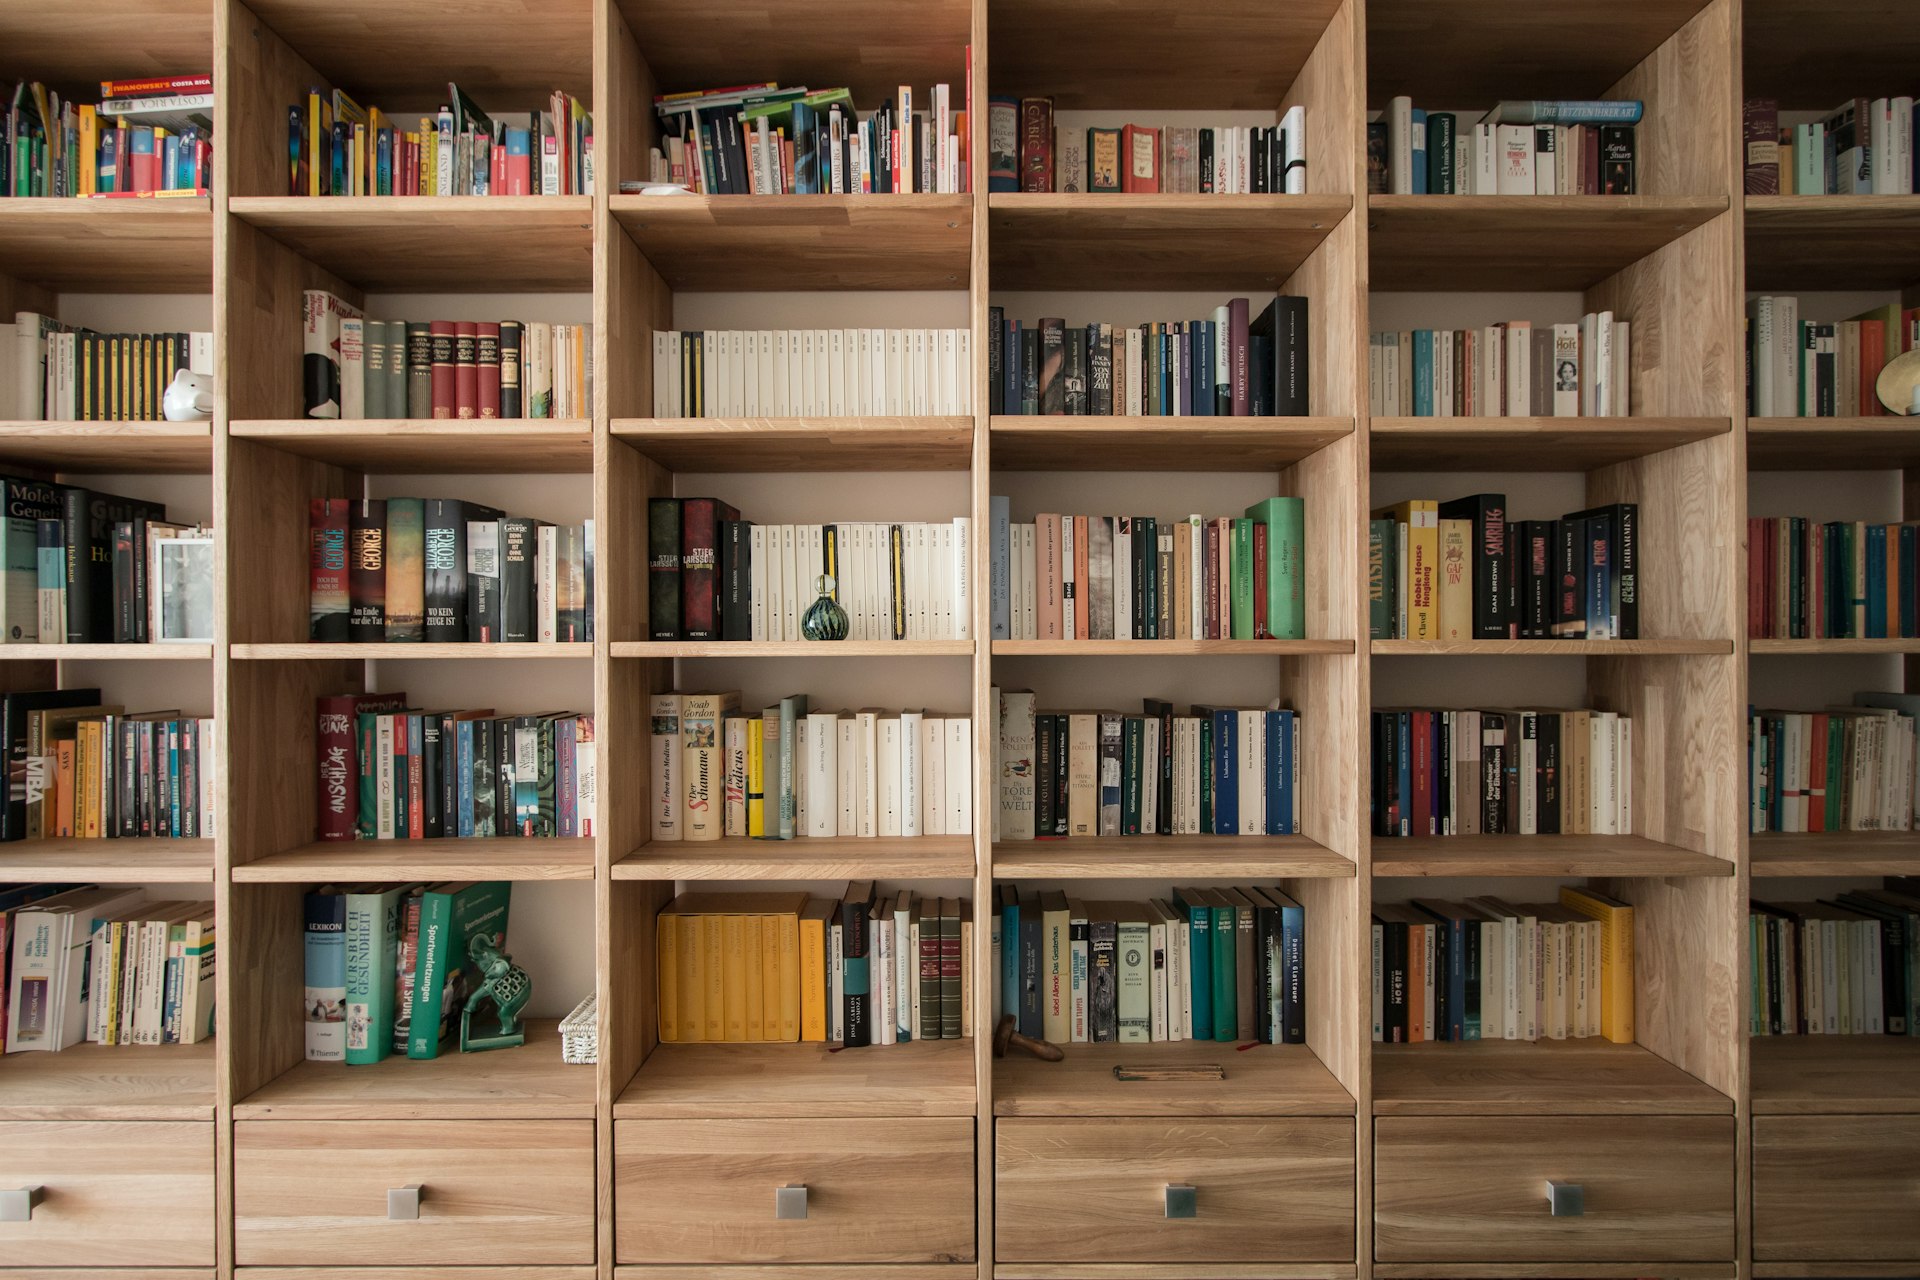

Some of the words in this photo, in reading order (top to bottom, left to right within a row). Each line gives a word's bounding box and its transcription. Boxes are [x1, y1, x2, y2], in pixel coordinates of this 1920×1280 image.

[113, 81, 170, 92] IWANOWSKI'S
[171, 79, 193, 88] COSTA
[194, 78, 211, 86] RICA
[140, 98, 165, 109] RICA
[168, 95, 205, 107] COSTA
[1543, 108, 1558, 117] DIE
[1557, 108, 1594, 117] LETZTEN
[1594, 108, 1620, 117] IHRER
[1621, 108, 1637, 117] ART
[993, 140, 1013, 149] Rose
[1605, 144, 1626, 152] Maria
[752, 146, 760, 170] AMRUM
[832, 148, 841, 193] HAMBURG
[1557, 340, 1576, 349] Holt
[1485, 508, 1504, 555] SAKRILEG
[325, 528, 345, 571] GEORGE
[362, 528, 382, 571] GEORGE
[426, 528, 437, 570] ELIZABETH
[437, 528, 455, 571] GEORGE
[1623, 514, 1631, 569] ERBARMEN
[683, 555, 715, 564] LARSSON
[692, 548, 714, 557] STIEG
[1594, 539, 1606, 566] METEOR
[68, 545, 76, 583] Holocaust
[650, 560, 679, 568] LARSSON
[1423, 567, 1431, 607] Hongkong
[351, 617, 362, 625] war
[371, 616, 383, 625] Tat
[353, 608, 362, 616] Am
[363, 608, 379, 616] Ende
[428, 608, 437, 616] WO
[438, 608, 454, 616] KEIN
[427, 617, 445, 625] ZEUGE
[446, 617, 456, 625] IST
[684, 709, 714, 717] Gordon
[689, 701, 709, 709] Noah
[320, 722, 349, 735] KING
[321, 761, 329, 778] DER
[727, 750, 744, 806] Medicus
[26, 756, 44, 804] MBA
[328, 746, 348, 813] ANSCHLAG
[688, 750, 708, 812] Schamane
[662, 784, 670, 804] Erben
[1002, 787, 1032, 795] TORE
[1002, 801, 1033, 810] WELT
[1489, 802, 1497, 831] WOLFE
[309, 923, 342, 931] LEXIKON
[348, 911, 359, 994] KURSBUCH
[359, 911, 370, 995] GESUNDHEIT
[421, 923, 438, 1003] Sportverletzungen
